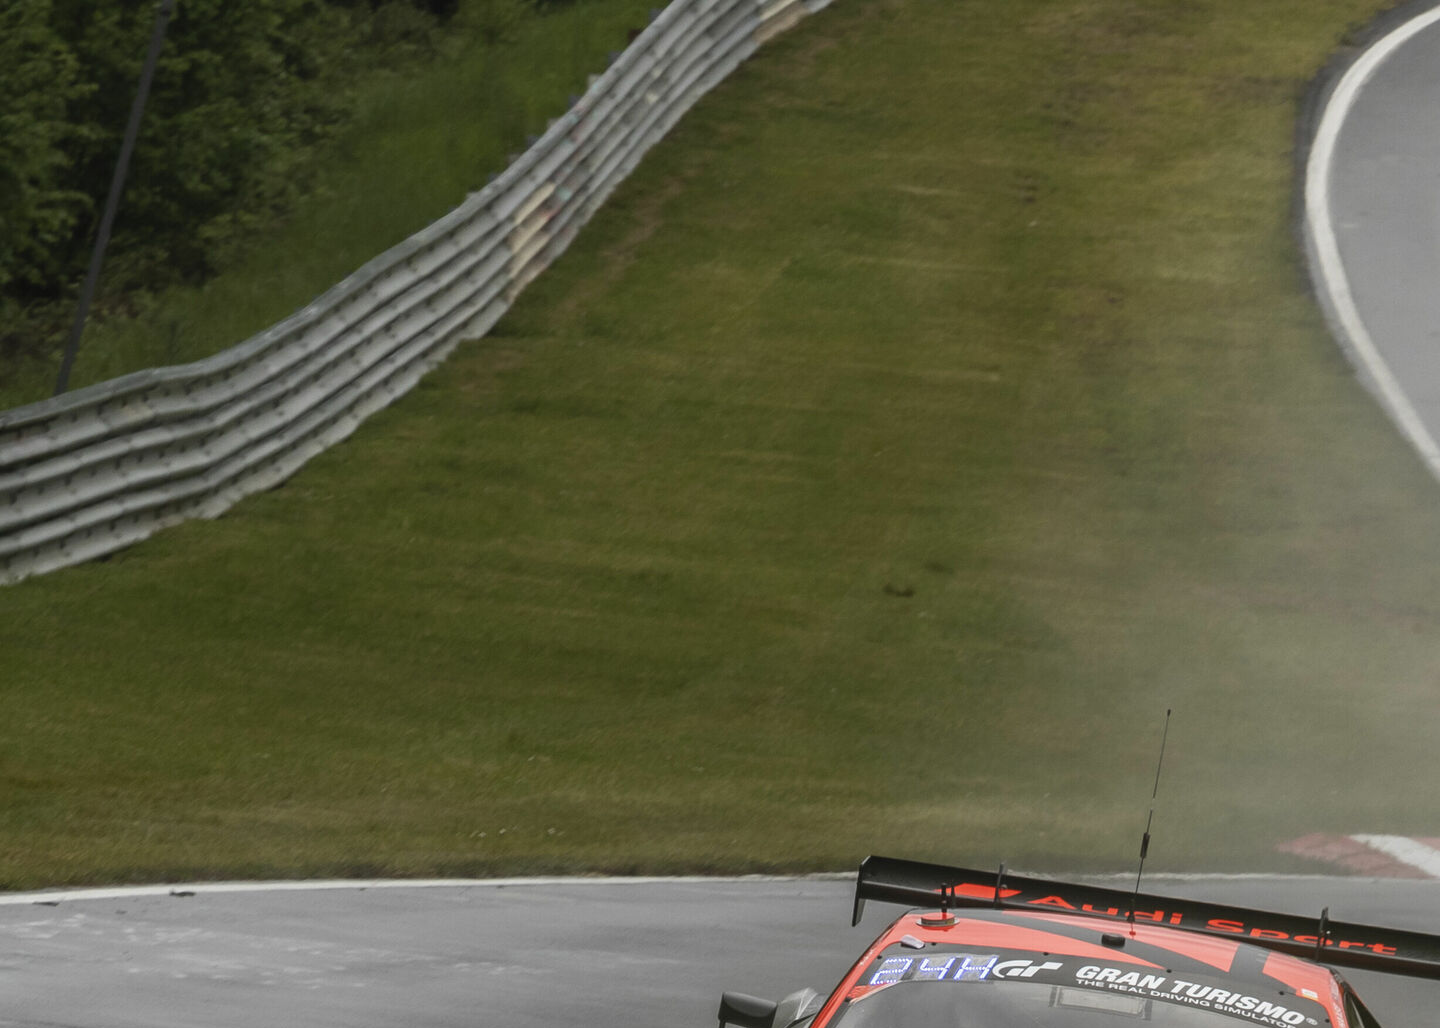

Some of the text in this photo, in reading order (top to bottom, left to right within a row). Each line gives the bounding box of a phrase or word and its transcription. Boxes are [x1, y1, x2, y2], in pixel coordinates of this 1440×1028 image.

[1027, 895, 1397, 956] Audi Sport
[870, 955, 999, 986] 24H
[1076, 978, 1105, 988] THE
[1108, 983, 1148, 995] REAL
[1150, 989, 1211, 1007] DRIVING
[1075, 965, 1166, 990] GRAN
[1168, 979, 1306, 1026] TURISMO
